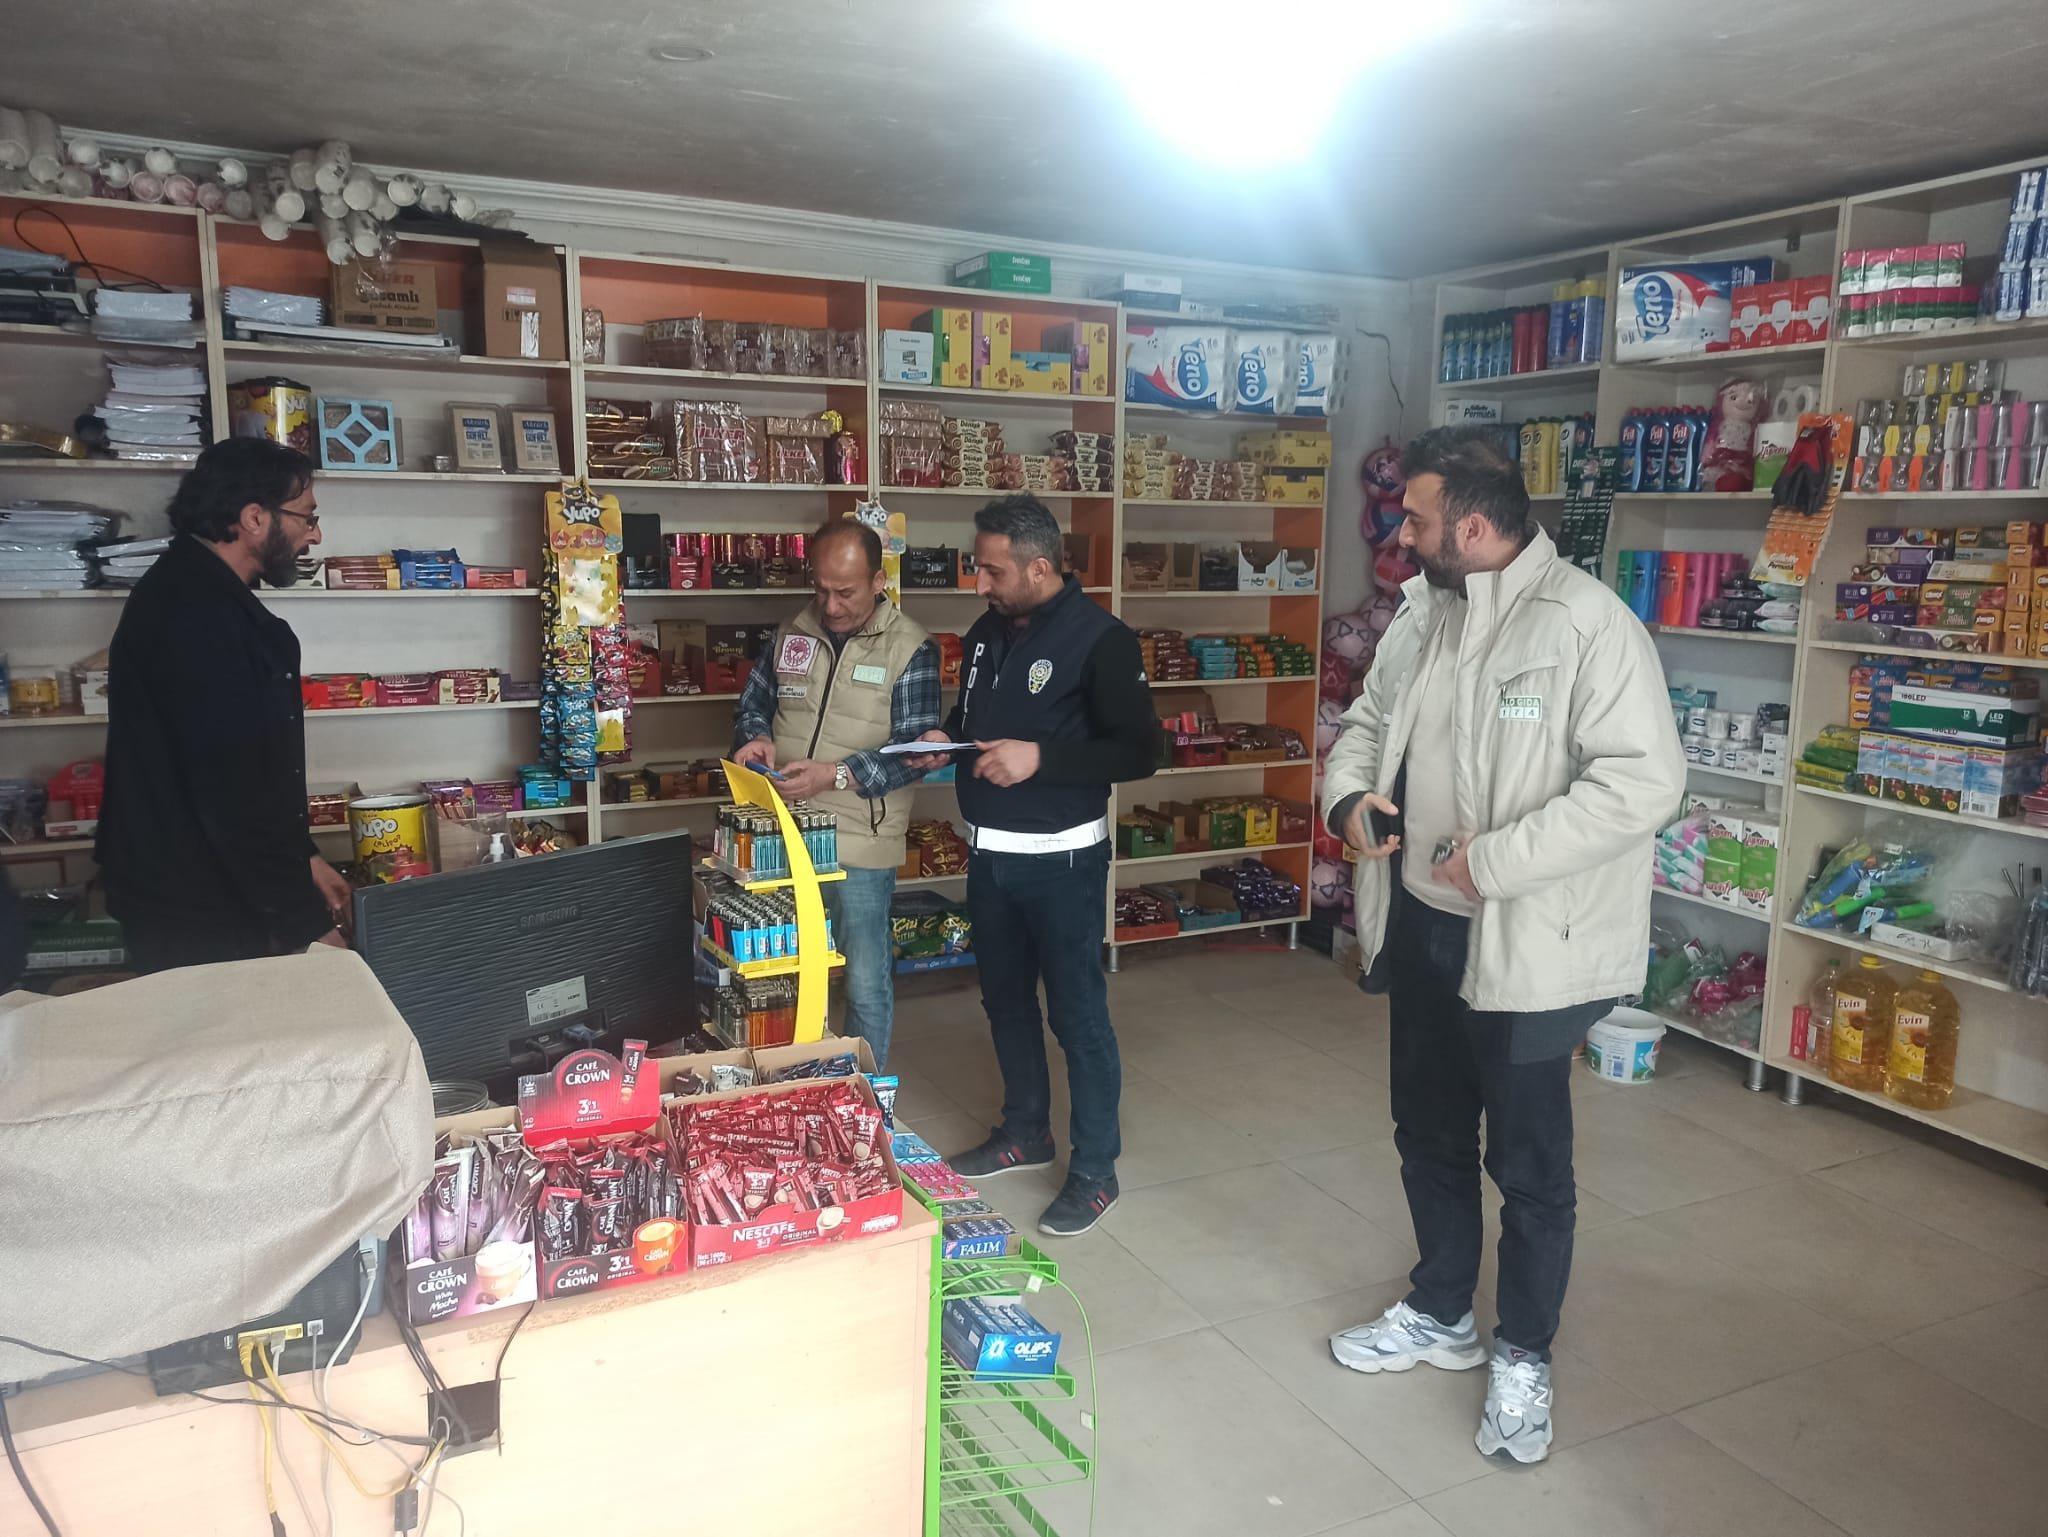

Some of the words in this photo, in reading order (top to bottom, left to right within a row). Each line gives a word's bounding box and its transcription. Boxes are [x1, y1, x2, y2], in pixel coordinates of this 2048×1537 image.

[1636, 279, 1670, 338] Teno
[1181, 342, 1206, 392] Teno
[1241, 351, 1266, 398] Teno
[1463, 407, 1497, 419] Permatik
[1650, 425, 1663, 440] Pril
[1673, 424, 1687, 439] Pril
[563, 505, 600, 525] Yupo
[1517, 698, 1540, 707] GIDA
[1989, 712, 2004, 720] LED
[354, 818, 399, 843] Yupo
[1838, 999, 1861, 1009] Evin
[1897, 1014, 1923, 1025] Evin
[576, 1060, 598, 1072] CAFÉ
[565, 1069, 610, 1086] CROWN
[576, 1114, 602, 1123] ORIGINAL
[733, 1223, 797, 1243] NESCAFE
[782, 1229, 817, 1241] ORIGINAL
[960, 1241, 1001, 1257] FALIM
[428, 1266, 453, 1281] CAFÉ
[567, 1266, 588, 1277] CAFÉ
[607, 1270, 636, 1280] ORIGINAL
[417, 1274, 468, 1295] CROWN
[556, 1274, 599, 1290] CROWN
[429, 1296, 459, 1313] Mocha
